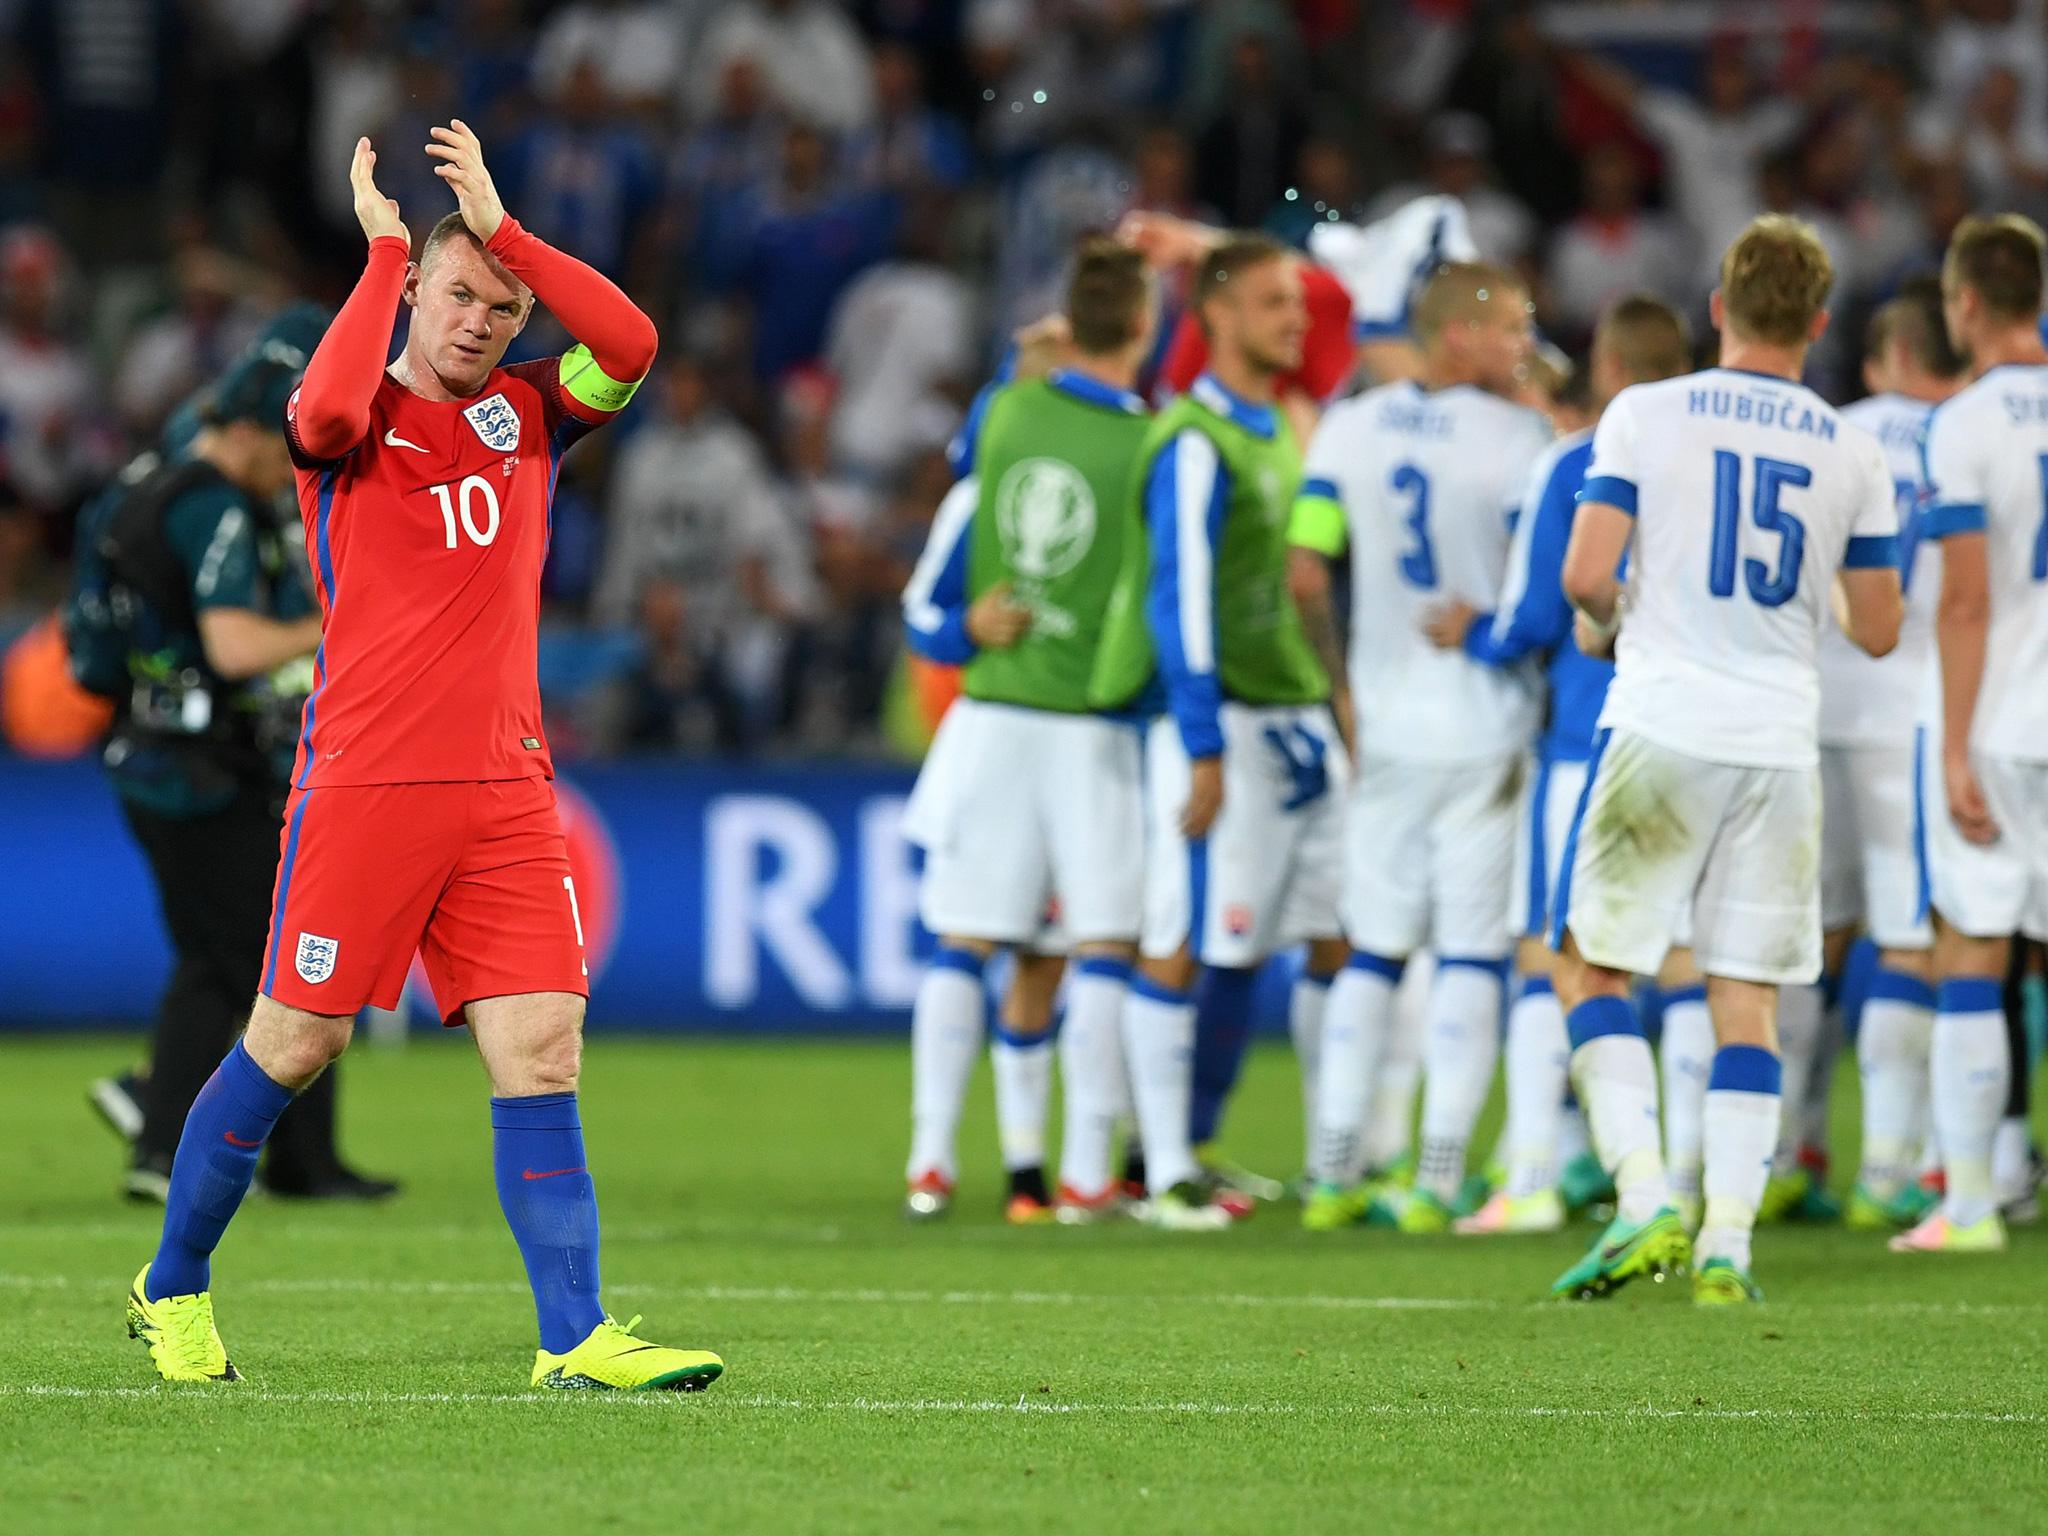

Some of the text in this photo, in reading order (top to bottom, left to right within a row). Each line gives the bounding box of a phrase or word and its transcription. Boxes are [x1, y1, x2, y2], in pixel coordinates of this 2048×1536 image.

[1689, 389, 1836, 441] HUBOČAN
[429, 474, 500, 549] 10
[1391, 464, 1437, 588] 3
[1709, 449, 1812, 607] 15
